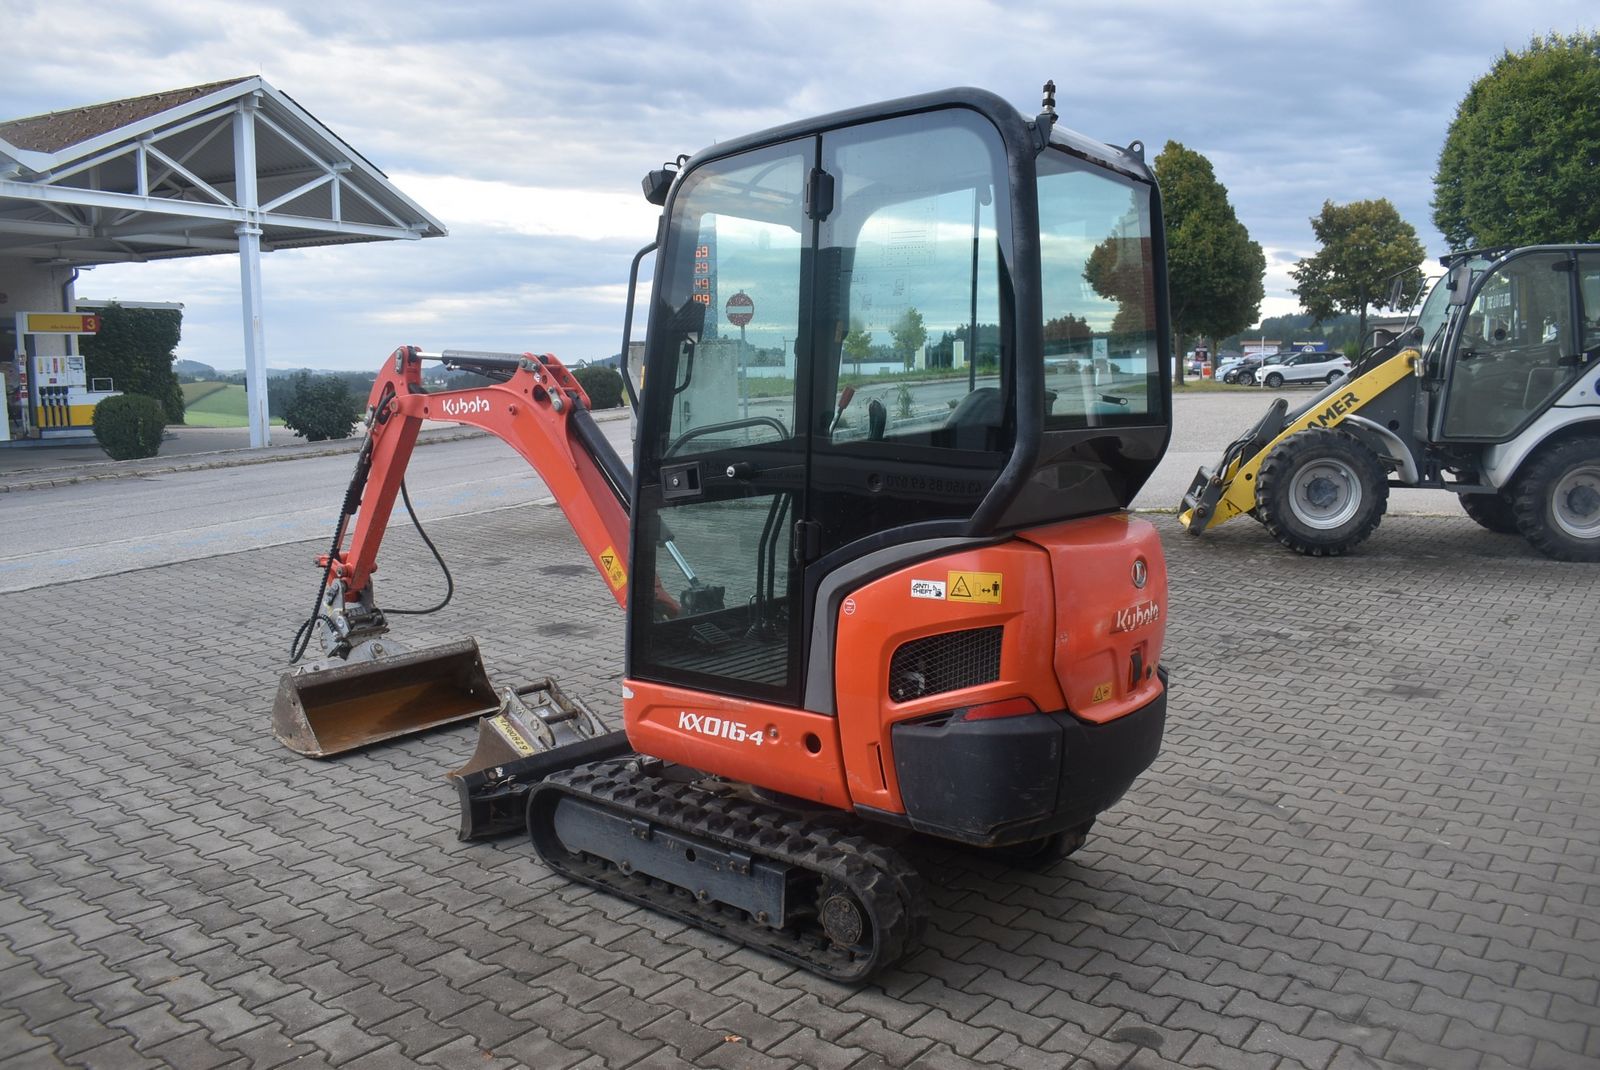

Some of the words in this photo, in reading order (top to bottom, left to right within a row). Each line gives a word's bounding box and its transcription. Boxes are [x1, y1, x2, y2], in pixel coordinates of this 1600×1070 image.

[87, 318, 97, 330] 3
[442, 395, 490, 415] Kubota
[1306, 391, 1360, 429] AMER
[1116, 600, 1159, 632] Kubota
